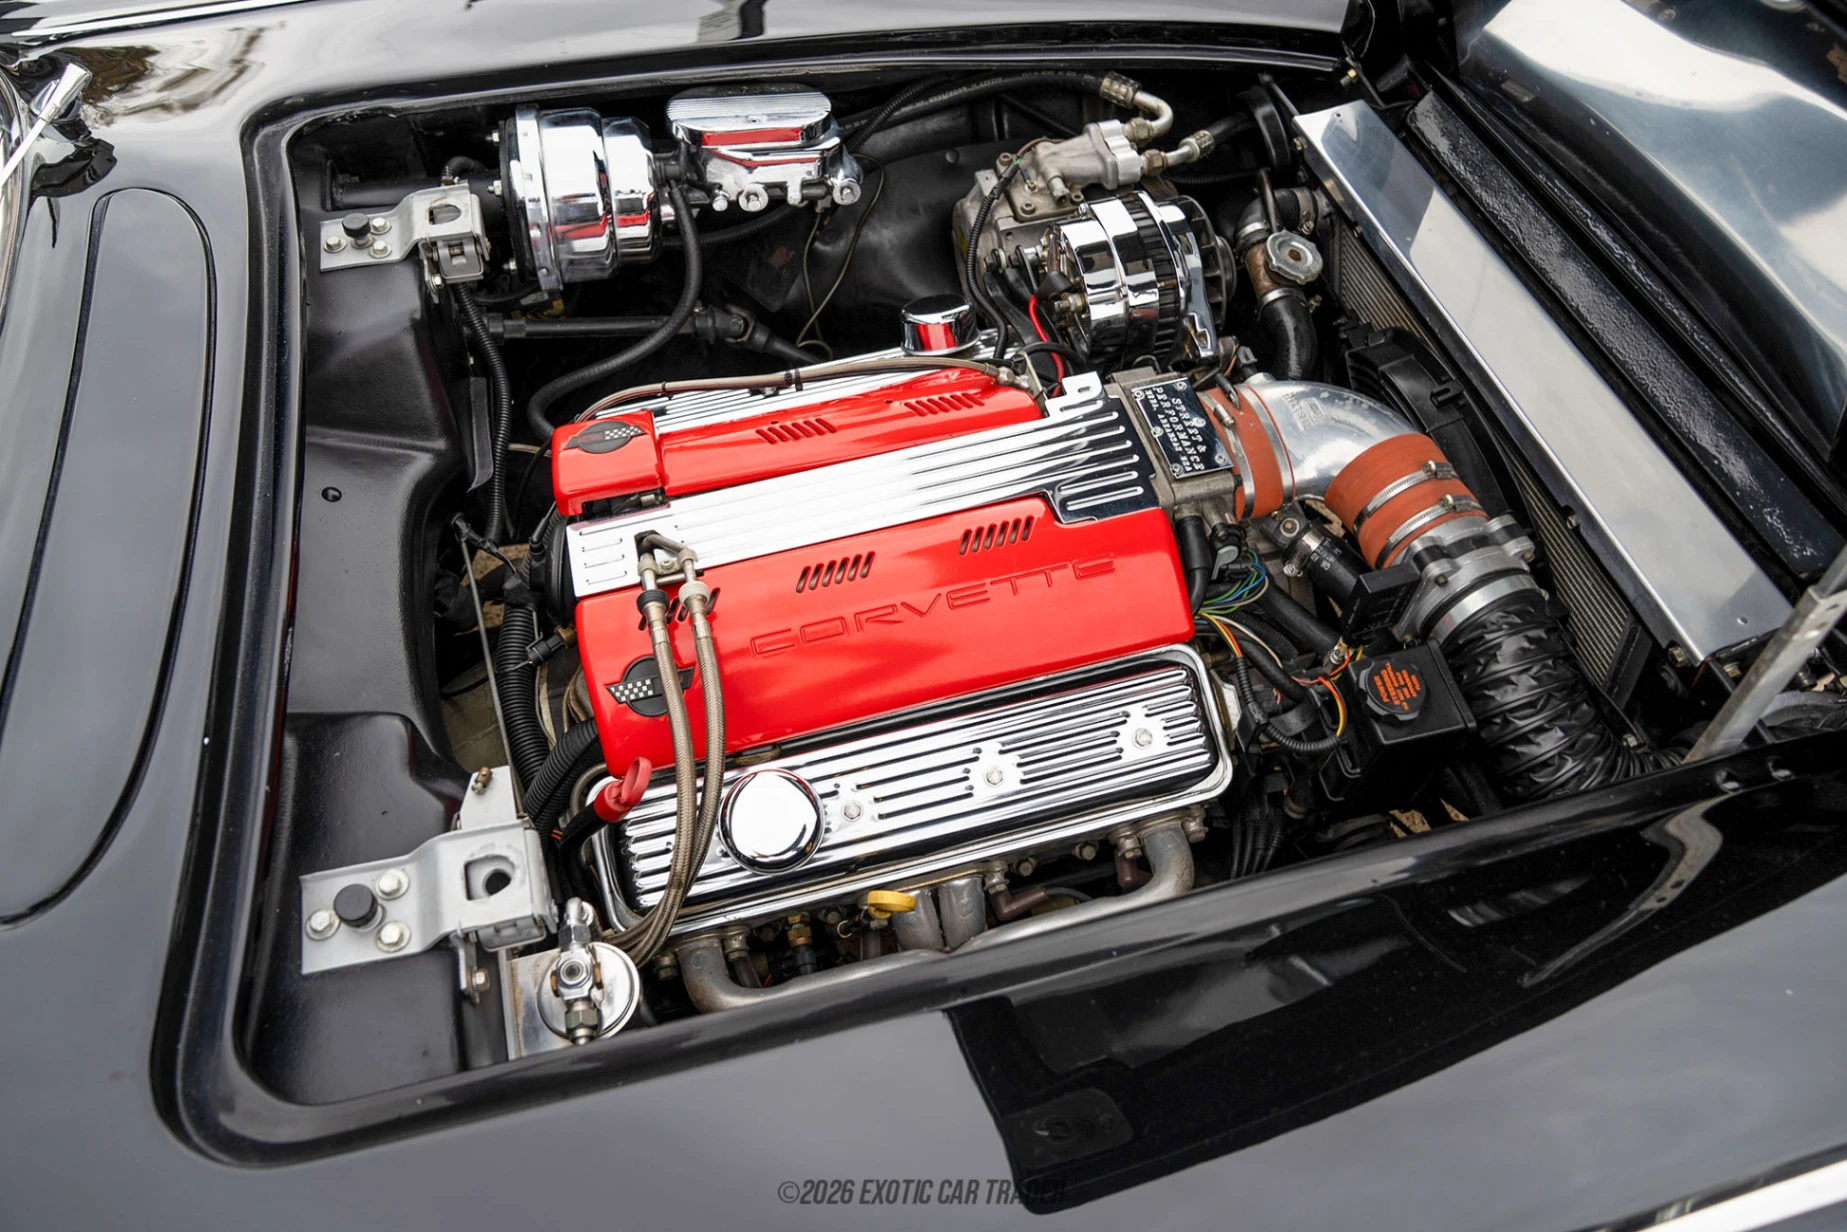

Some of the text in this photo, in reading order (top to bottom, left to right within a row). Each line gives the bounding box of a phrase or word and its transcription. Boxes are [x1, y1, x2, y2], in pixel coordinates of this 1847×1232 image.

[1153, 387, 1205, 470] PERFORMANCE
[1172, 398, 1206, 453] STREET &
[750, 553, 1116, 659] CORVETTE
